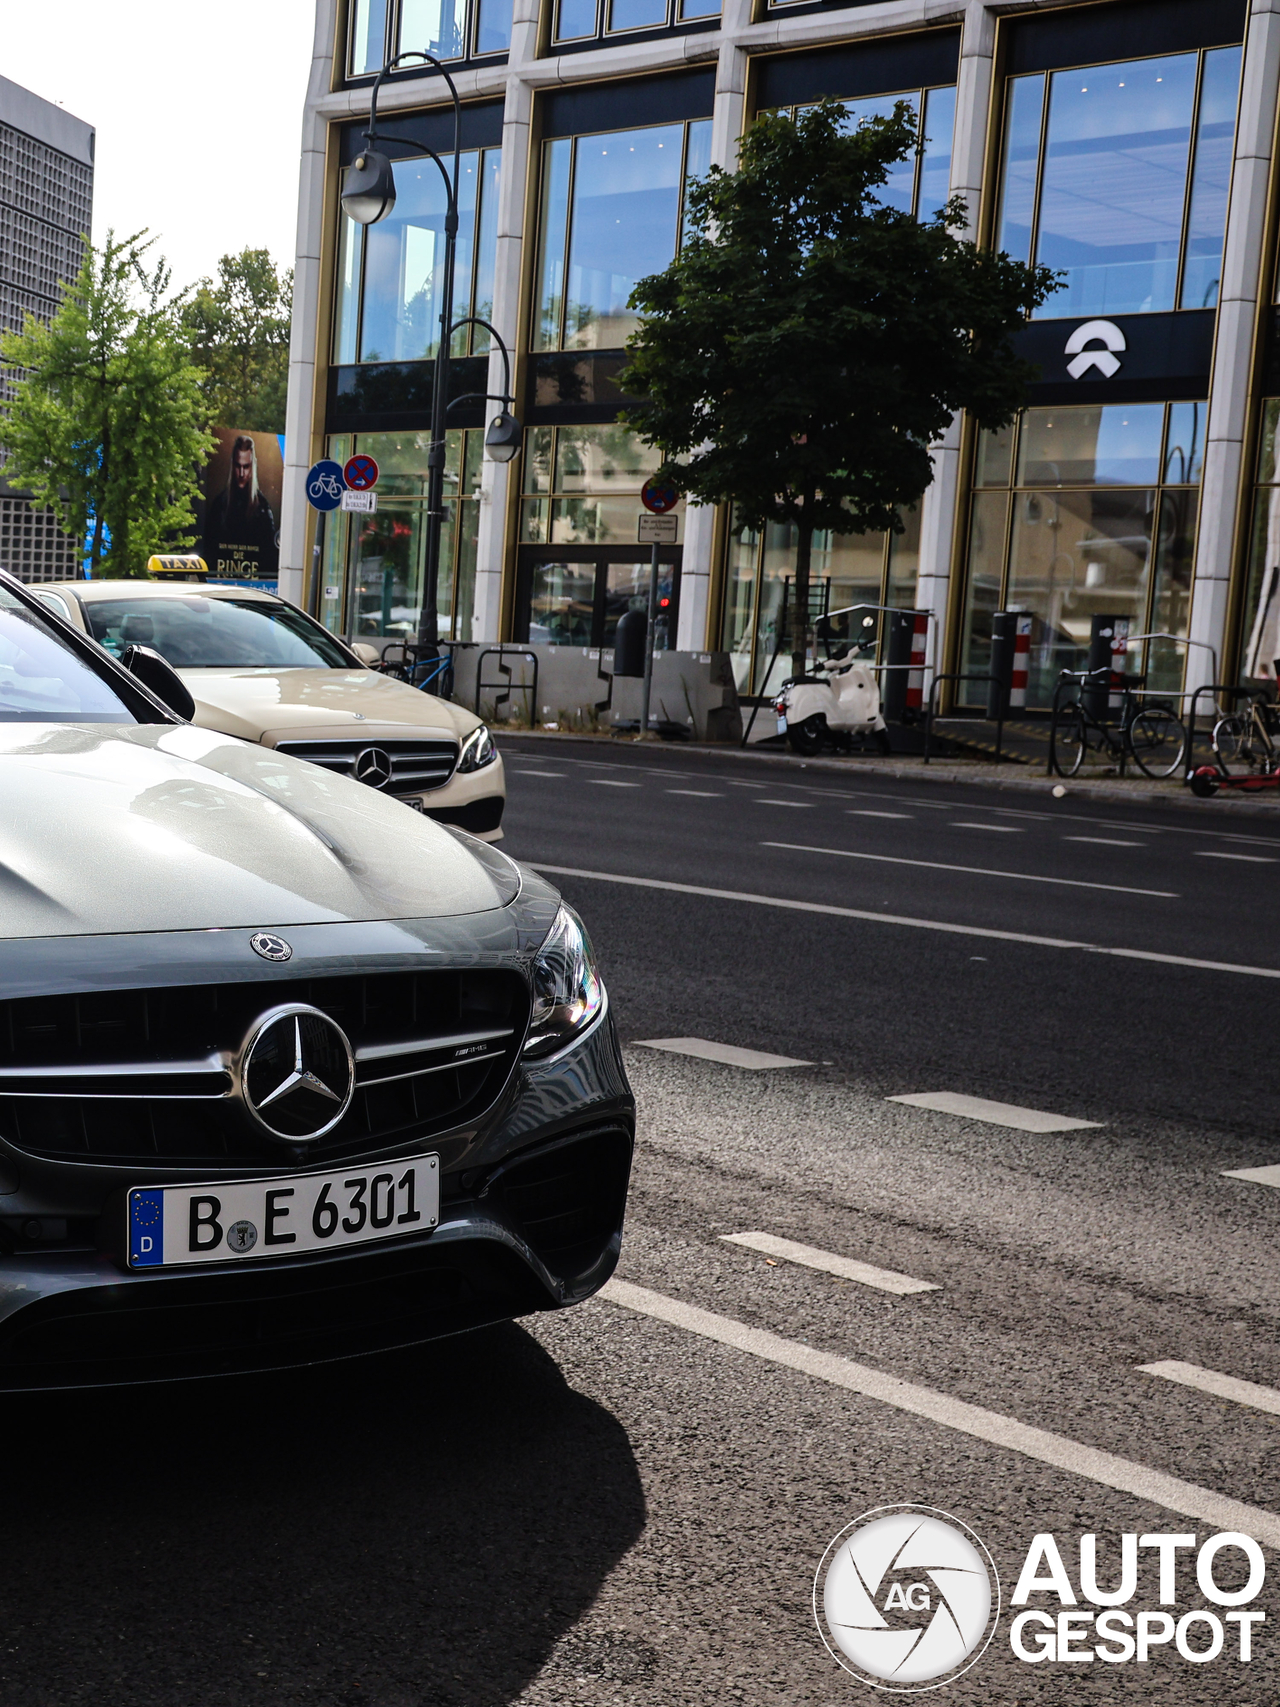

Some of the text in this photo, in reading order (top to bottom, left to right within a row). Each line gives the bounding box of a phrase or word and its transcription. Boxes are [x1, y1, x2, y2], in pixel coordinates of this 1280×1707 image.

[163, 558, 202, 569] TAXI
[233, 551, 244, 560] DIE
[217, 559, 260, 580] RINGE
[189, 1168, 421, 1252] B E 6301
[140, 1236, 153, 1252] D
